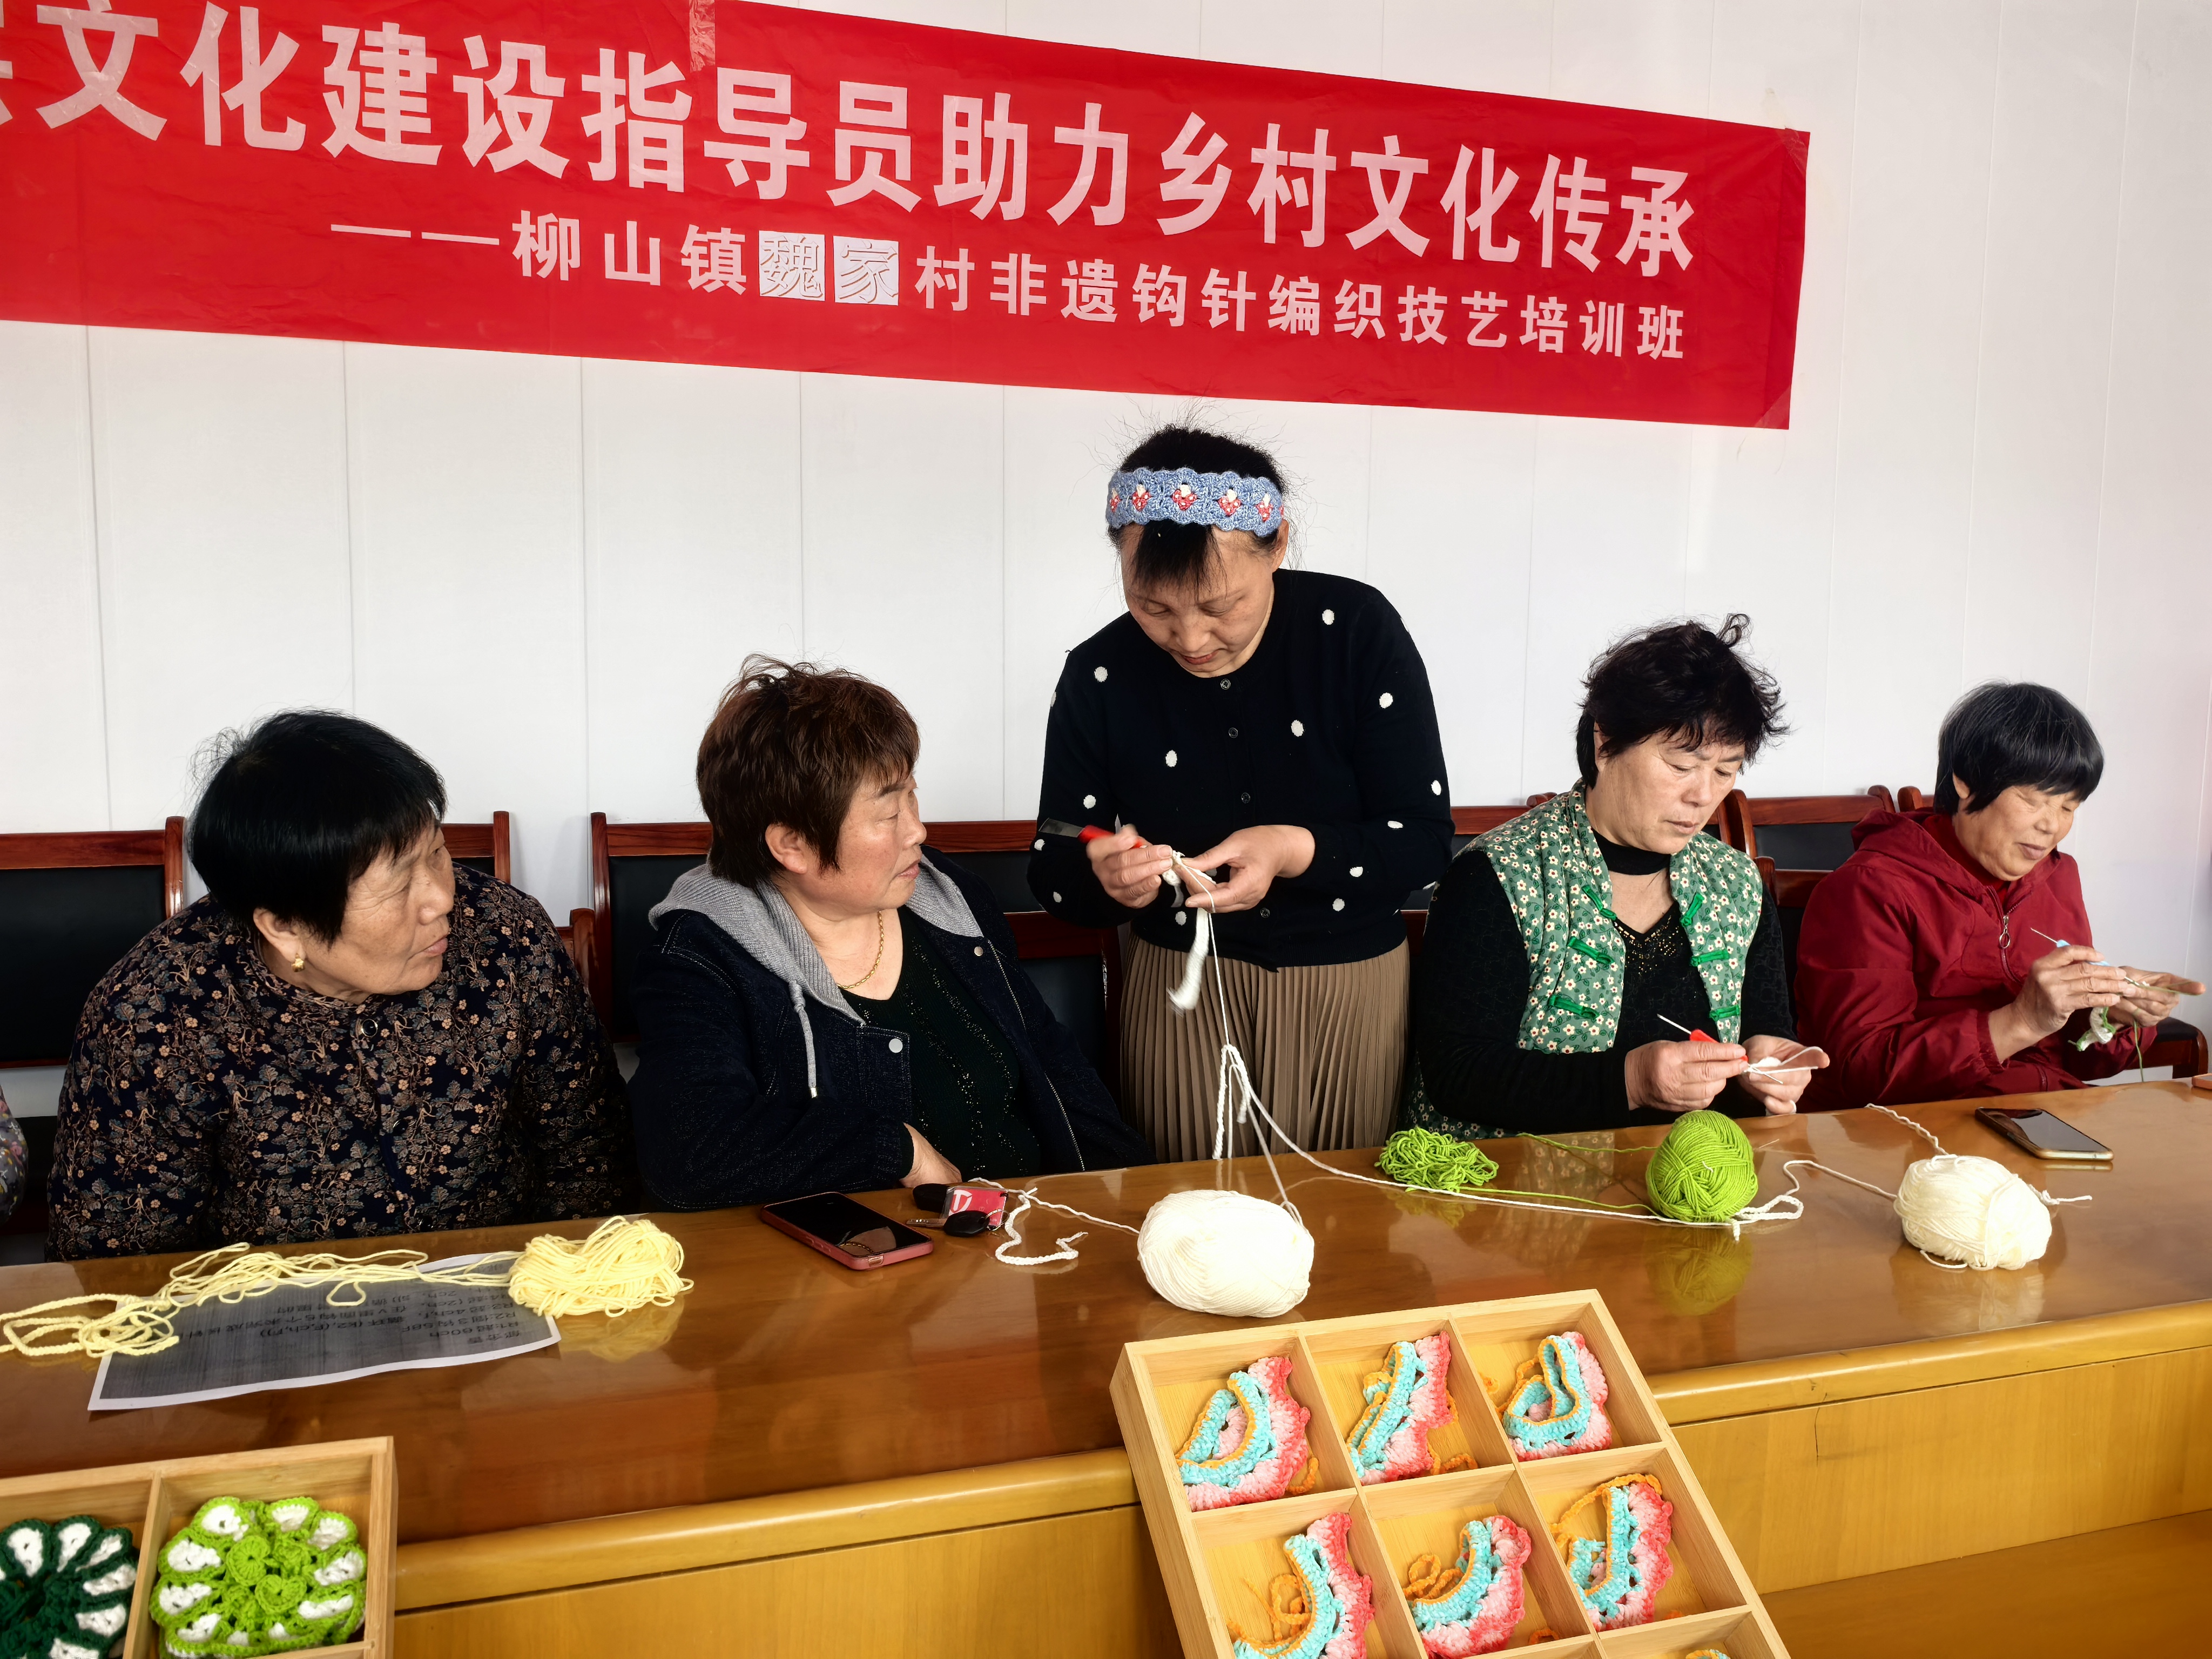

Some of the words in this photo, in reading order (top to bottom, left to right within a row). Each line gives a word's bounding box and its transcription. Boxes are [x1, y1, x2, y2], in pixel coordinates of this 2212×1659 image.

[0, 0, 1694, 276] 文化建设指导员助力乡村文化传承
